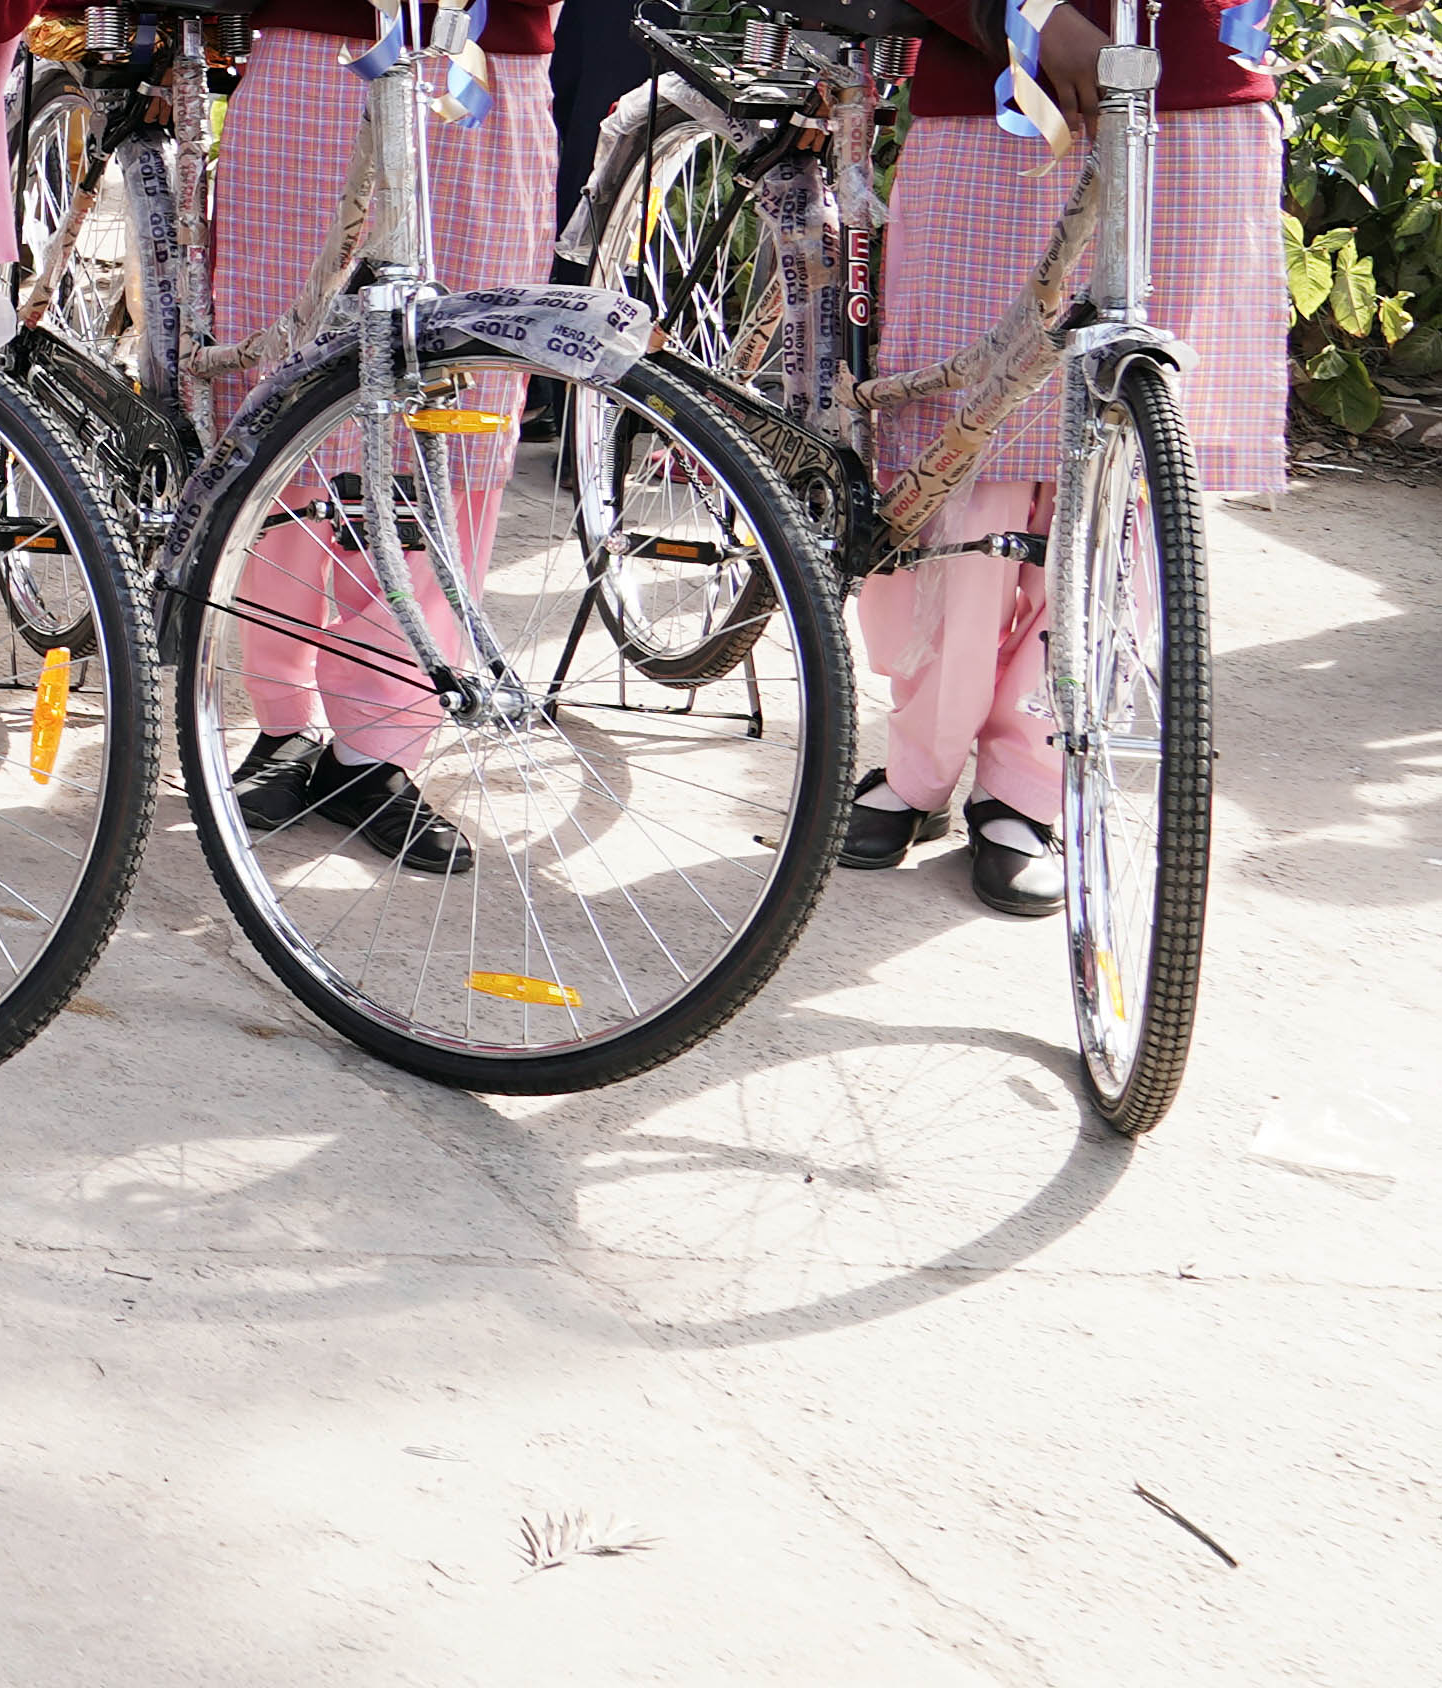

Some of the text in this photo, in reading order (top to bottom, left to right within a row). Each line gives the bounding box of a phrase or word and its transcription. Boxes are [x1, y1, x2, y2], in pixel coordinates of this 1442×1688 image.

[149, 212, 168, 263] GOLD
[158, 279, 175, 331] GOLD
[465, 291, 520, 308] GOLD
[534, 297, 588, 312] GOLD
[781, 254, 796, 306] GOLD
[471, 320, 526, 341] GOLD
[820, 285, 835, 338] GOLD
[782, 322, 796, 376] GOLD
[892, 489, 921, 518] GOLD
